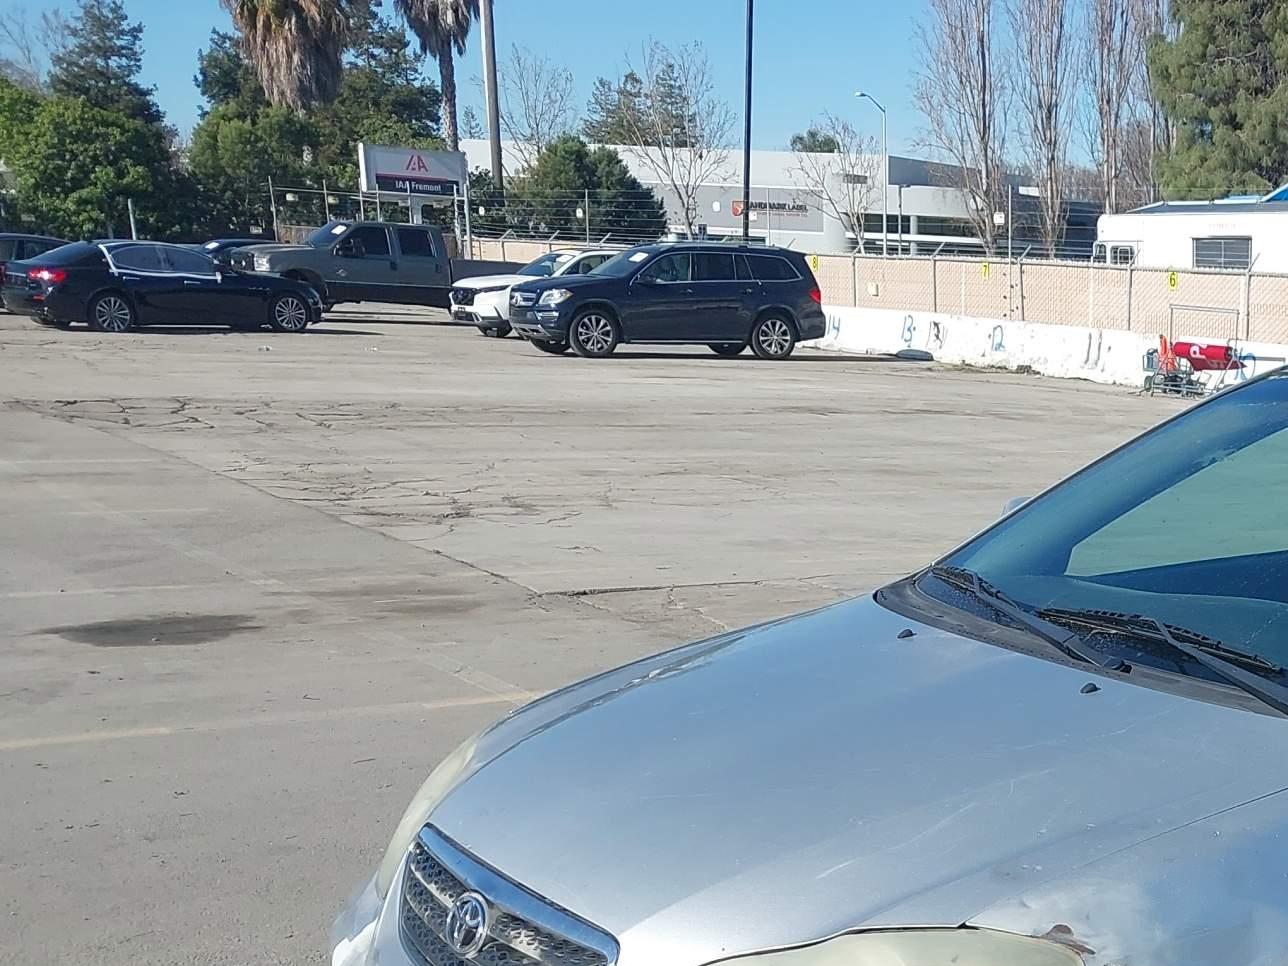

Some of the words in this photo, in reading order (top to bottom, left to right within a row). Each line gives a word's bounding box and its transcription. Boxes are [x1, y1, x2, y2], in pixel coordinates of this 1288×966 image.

[411, 182, 441, 192] Fremont
[1169, 272, 1176, 287] 6
[826, 314, 841, 340] 14
[901, 314, 914, 343] 13
